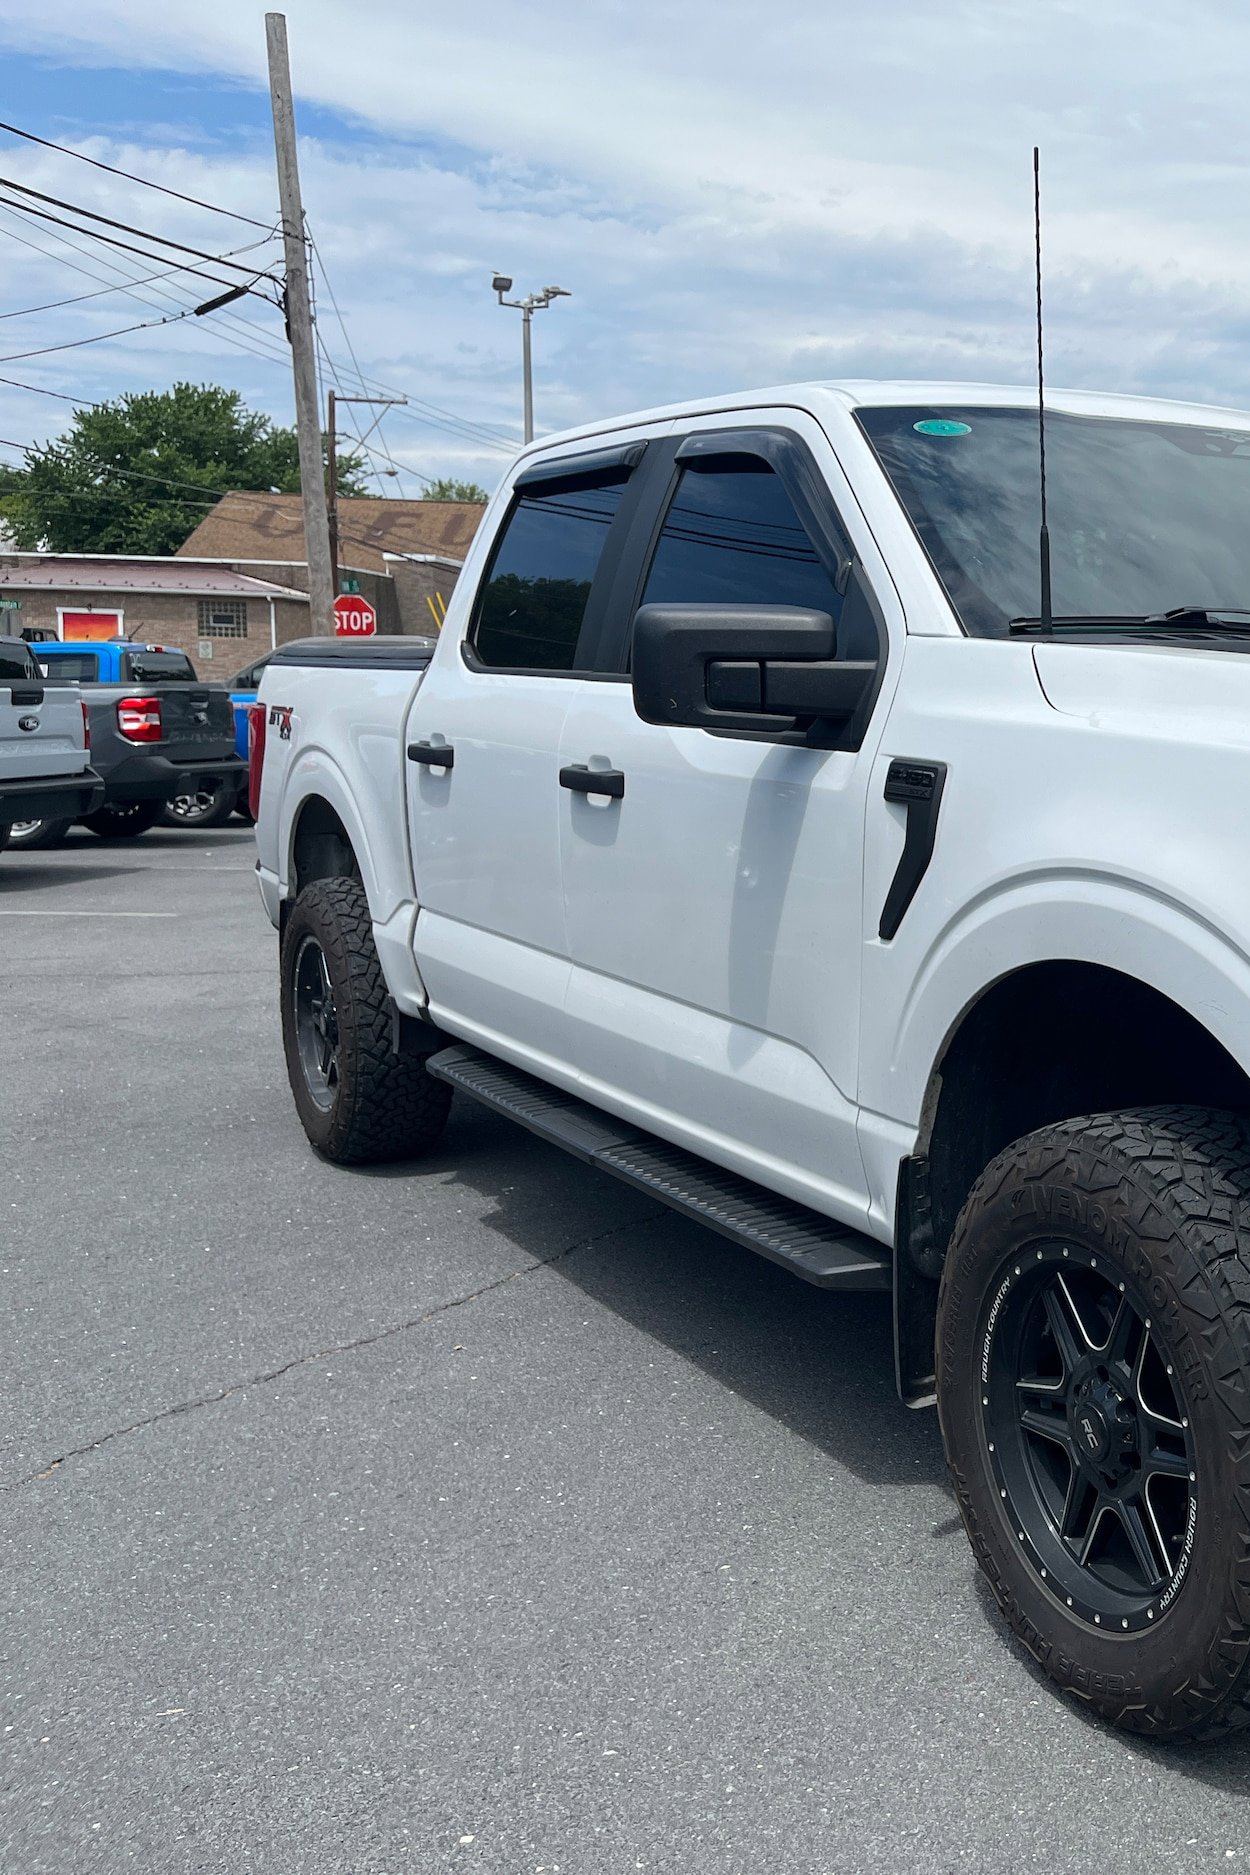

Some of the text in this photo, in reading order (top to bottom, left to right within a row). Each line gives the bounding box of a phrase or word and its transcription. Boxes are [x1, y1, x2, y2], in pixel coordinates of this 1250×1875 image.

[333, 610, 373, 631] STOP
[981, 1276, 1012, 1383] ROUGH COUNTRY
[1081, 1418, 1099, 1449] RC
[1159, 1496, 1197, 1611] ROUGH COUNTRY
